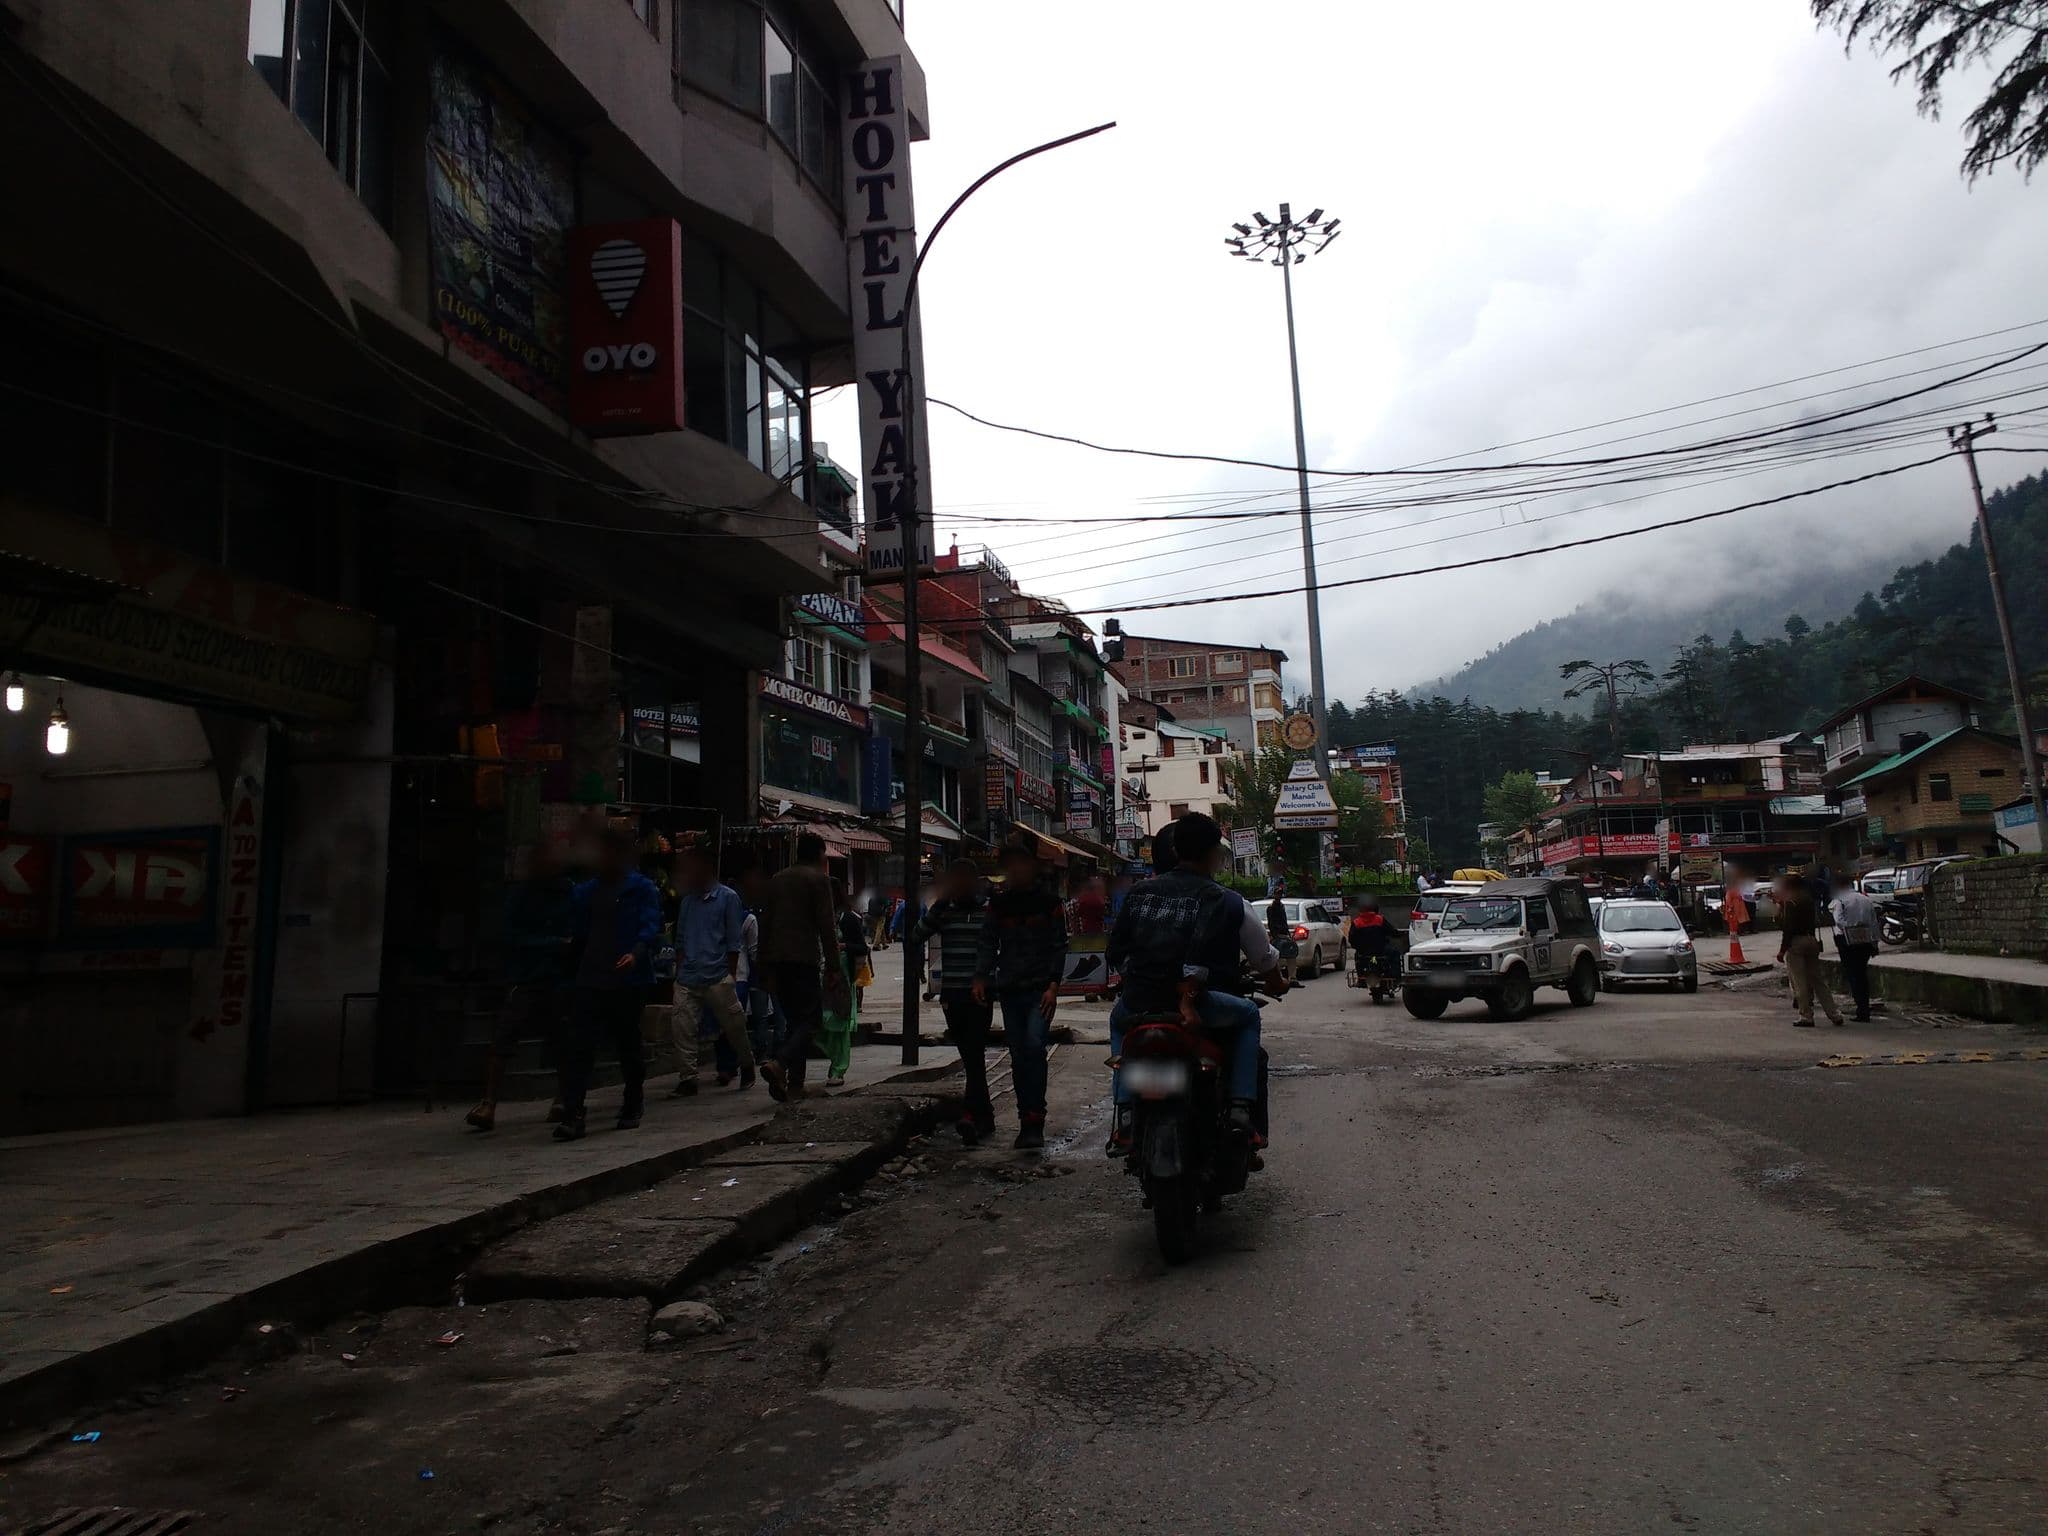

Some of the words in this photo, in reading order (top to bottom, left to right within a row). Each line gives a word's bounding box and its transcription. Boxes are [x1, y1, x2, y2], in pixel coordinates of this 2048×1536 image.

[848, 68, 903, 330] HOTEL
[583, 342, 656, 373] OYO
[866, 368, 917, 531] YAK
[869, 545, 929, 570] MANLI
[763, 676, 803, 704] MONTE
[803, 691, 837, 715] CARLO
[670, 713, 698, 725] PAWA
[813, 738, 832, 758] SALE
[232, 798, 255, 826] A
[1104, 792, 1113, 834] SONY
[234, 835, 256, 853] TO
[231, 859, 256, 884] Z
[221, 891, 249, 1026] ITEMS
